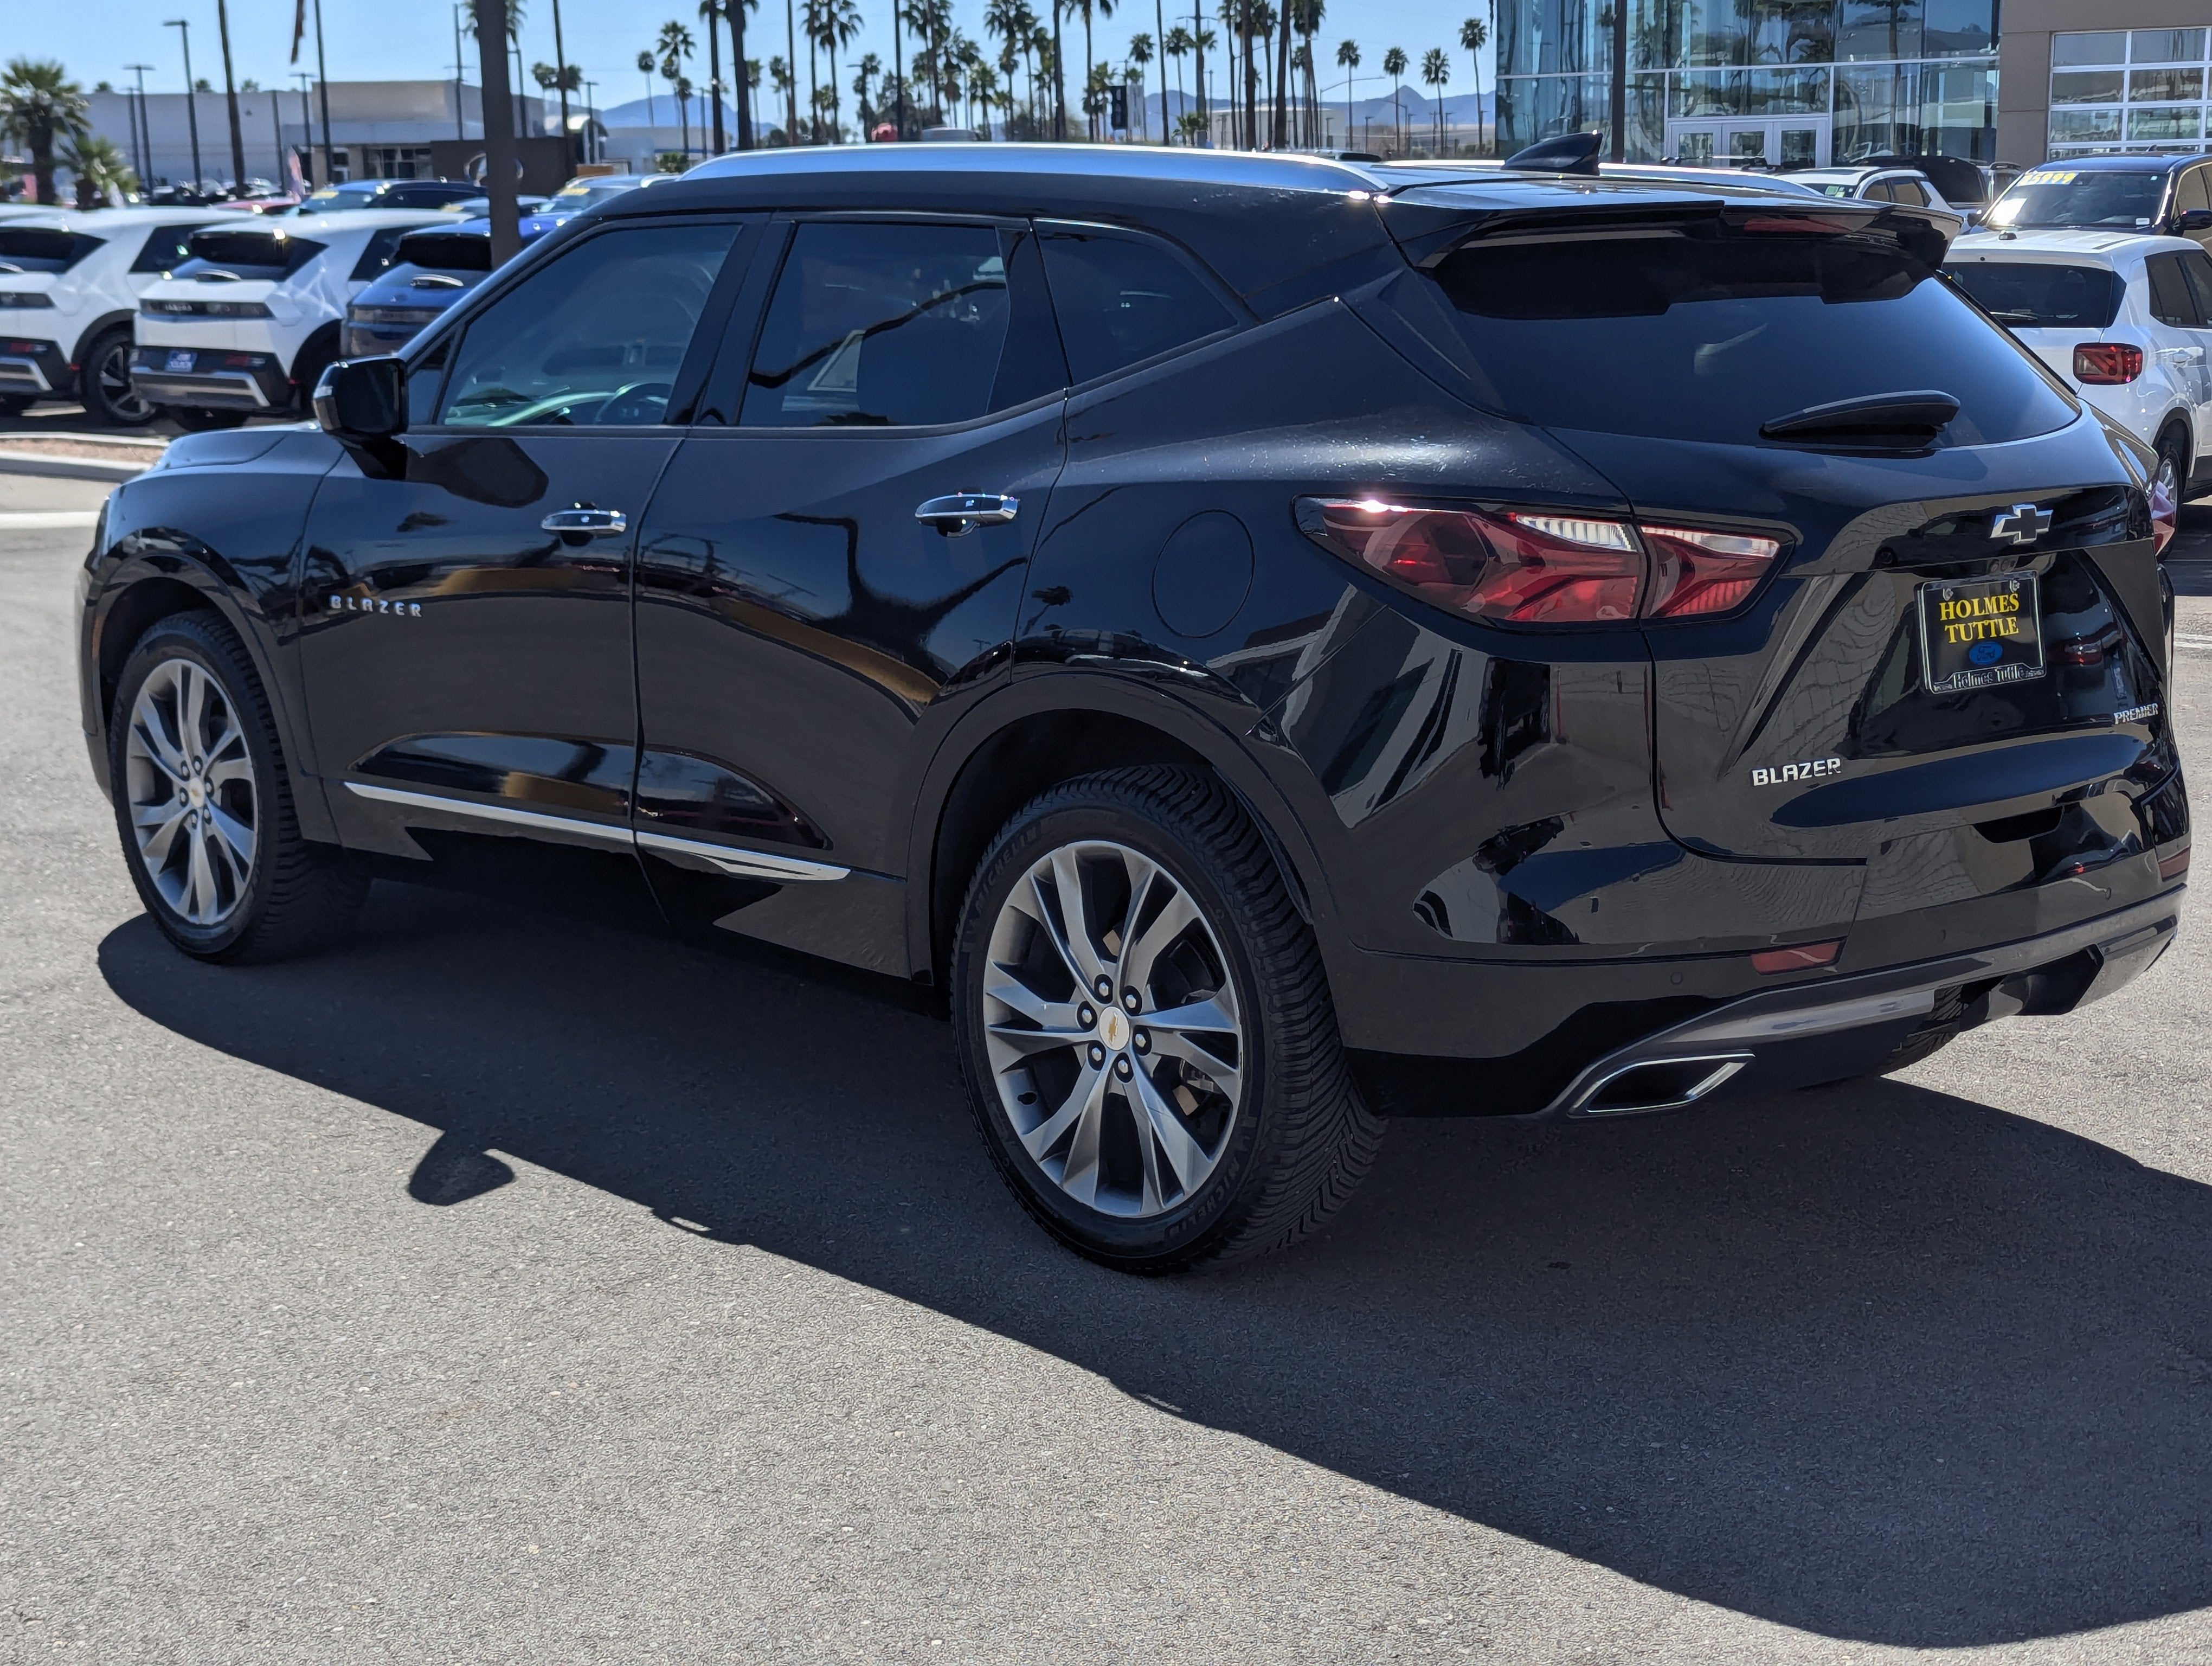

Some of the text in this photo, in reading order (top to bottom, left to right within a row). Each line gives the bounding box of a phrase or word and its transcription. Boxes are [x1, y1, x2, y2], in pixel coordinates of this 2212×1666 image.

[329, 595, 422, 618] BLAZER
[1939, 593, 2020, 621] HOLMES
[1944, 617, 2019, 643] TUTTLE
[2113, 703, 2158, 725] PREMIER
[1752, 758, 1841, 786] BLAZER
